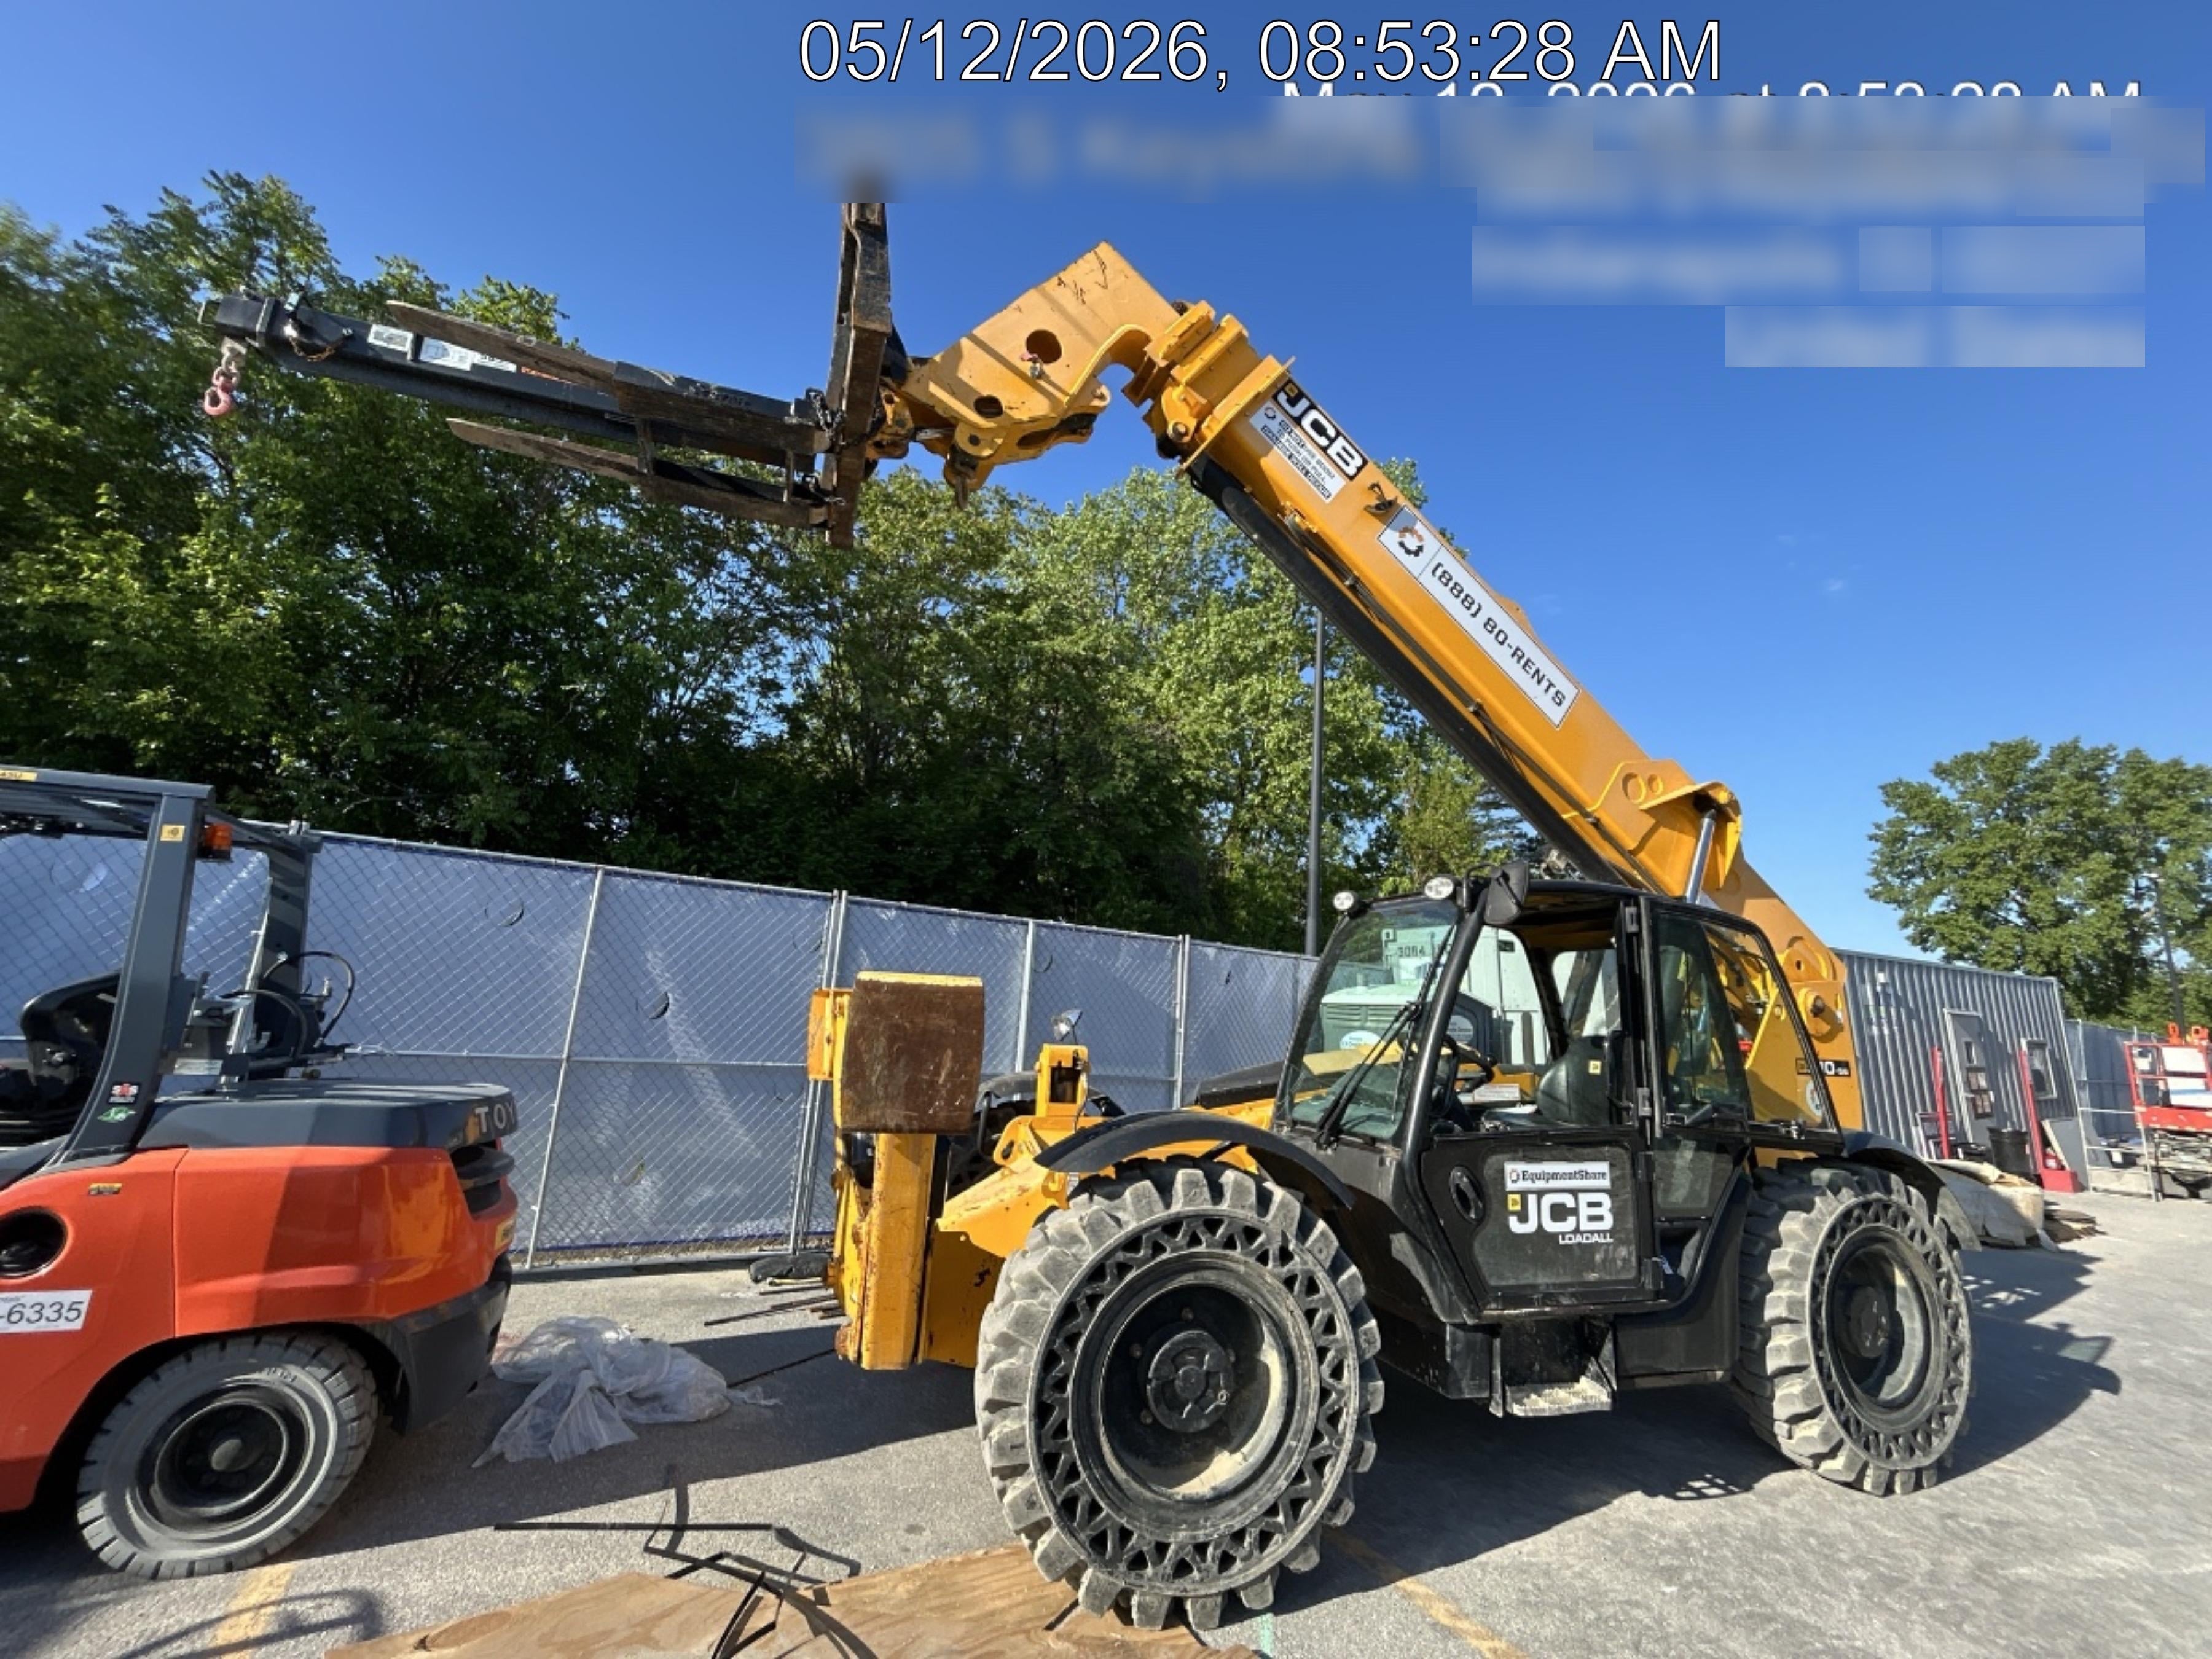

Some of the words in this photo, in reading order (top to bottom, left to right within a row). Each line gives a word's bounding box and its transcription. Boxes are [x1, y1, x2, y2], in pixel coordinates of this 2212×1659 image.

[1277, 390, 1363, 477] JCB
[1431, 562, 1482, 618] (888)
[1483, 616, 1566, 707] 80-RENTS
[1521, 1169, 1607, 1184] EquipmentShare
[1508, 1192, 1614, 1234] JCB
[1558, 1232, 1614, 1245] LOADALL
